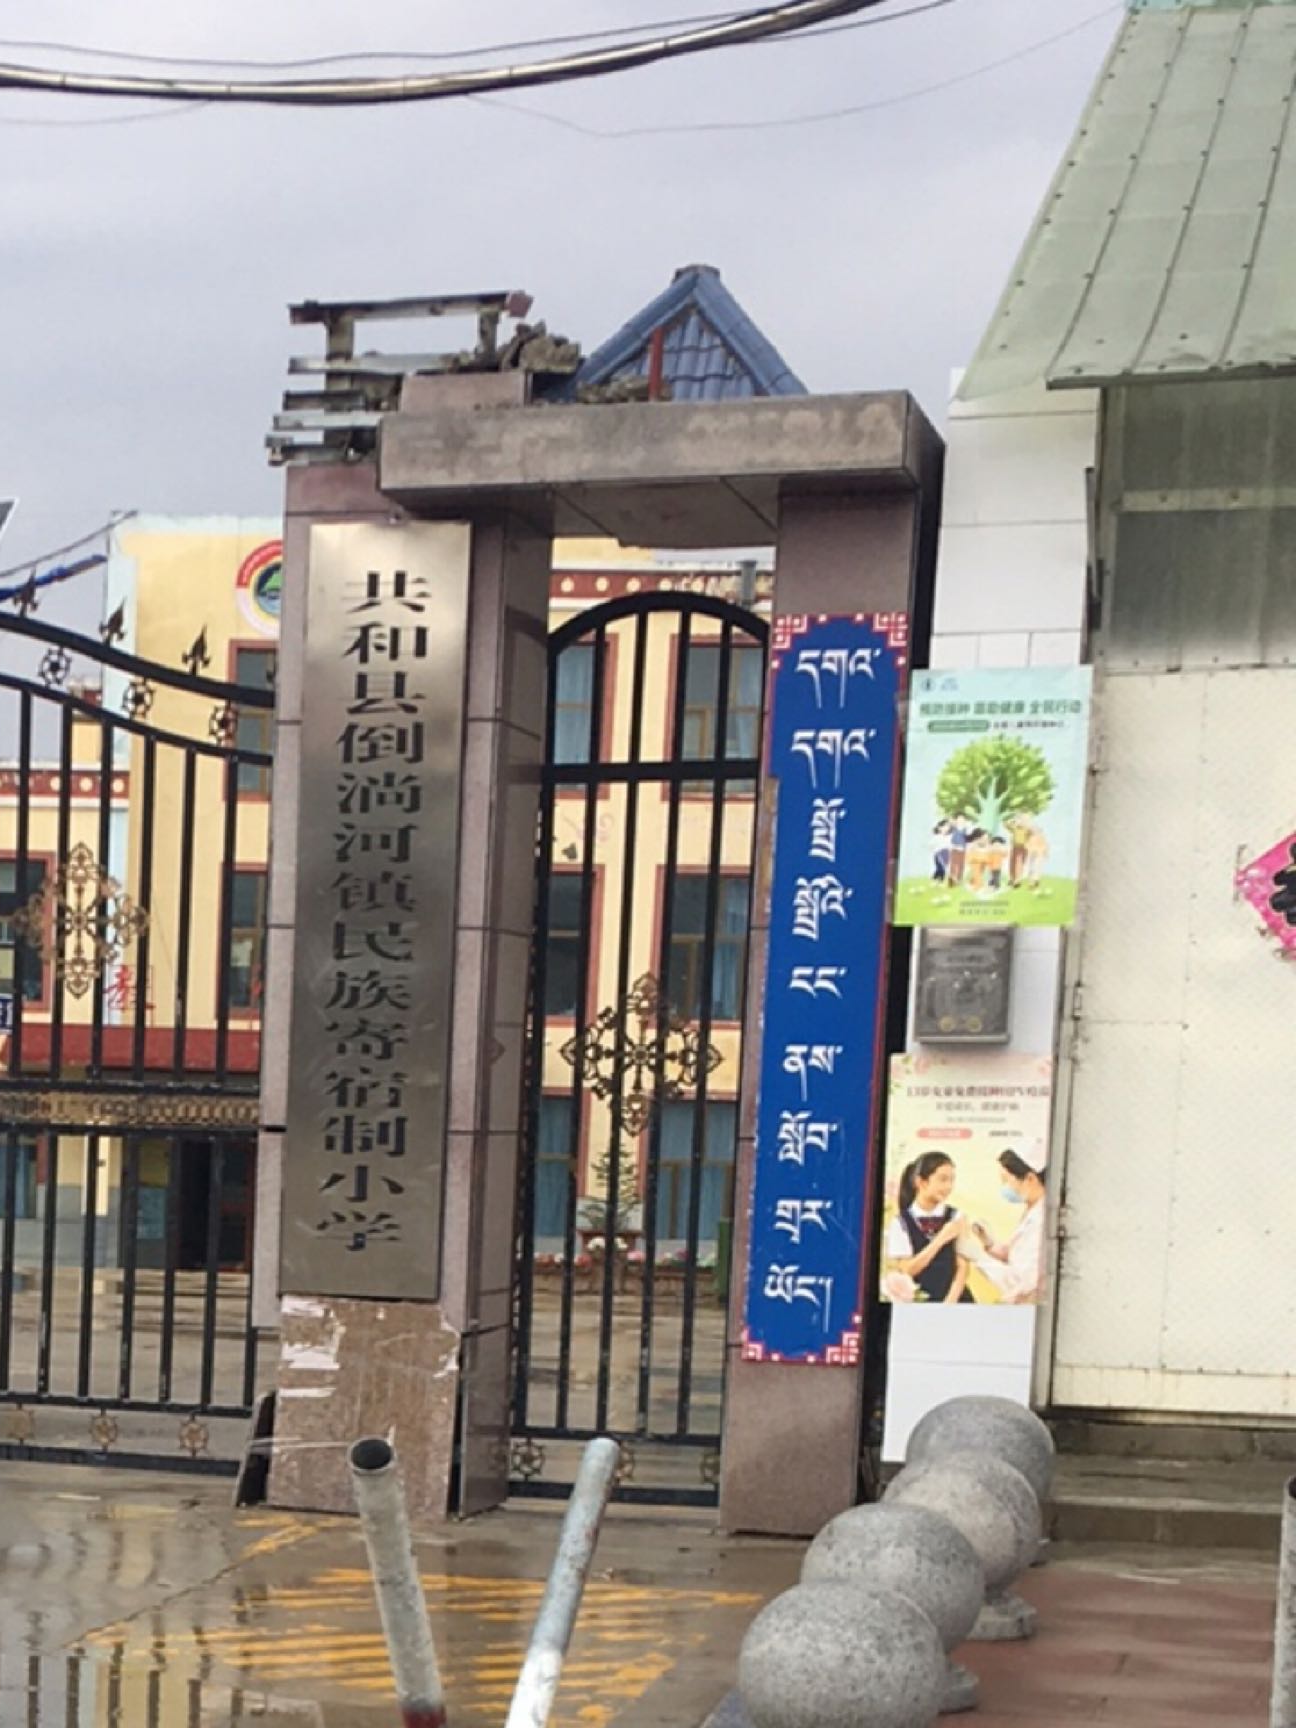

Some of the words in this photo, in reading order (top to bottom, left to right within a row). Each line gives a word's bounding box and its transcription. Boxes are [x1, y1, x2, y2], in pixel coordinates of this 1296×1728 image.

[316, 571, 431, 1252] 共和县倒淌河镇民族寄宿制小学
